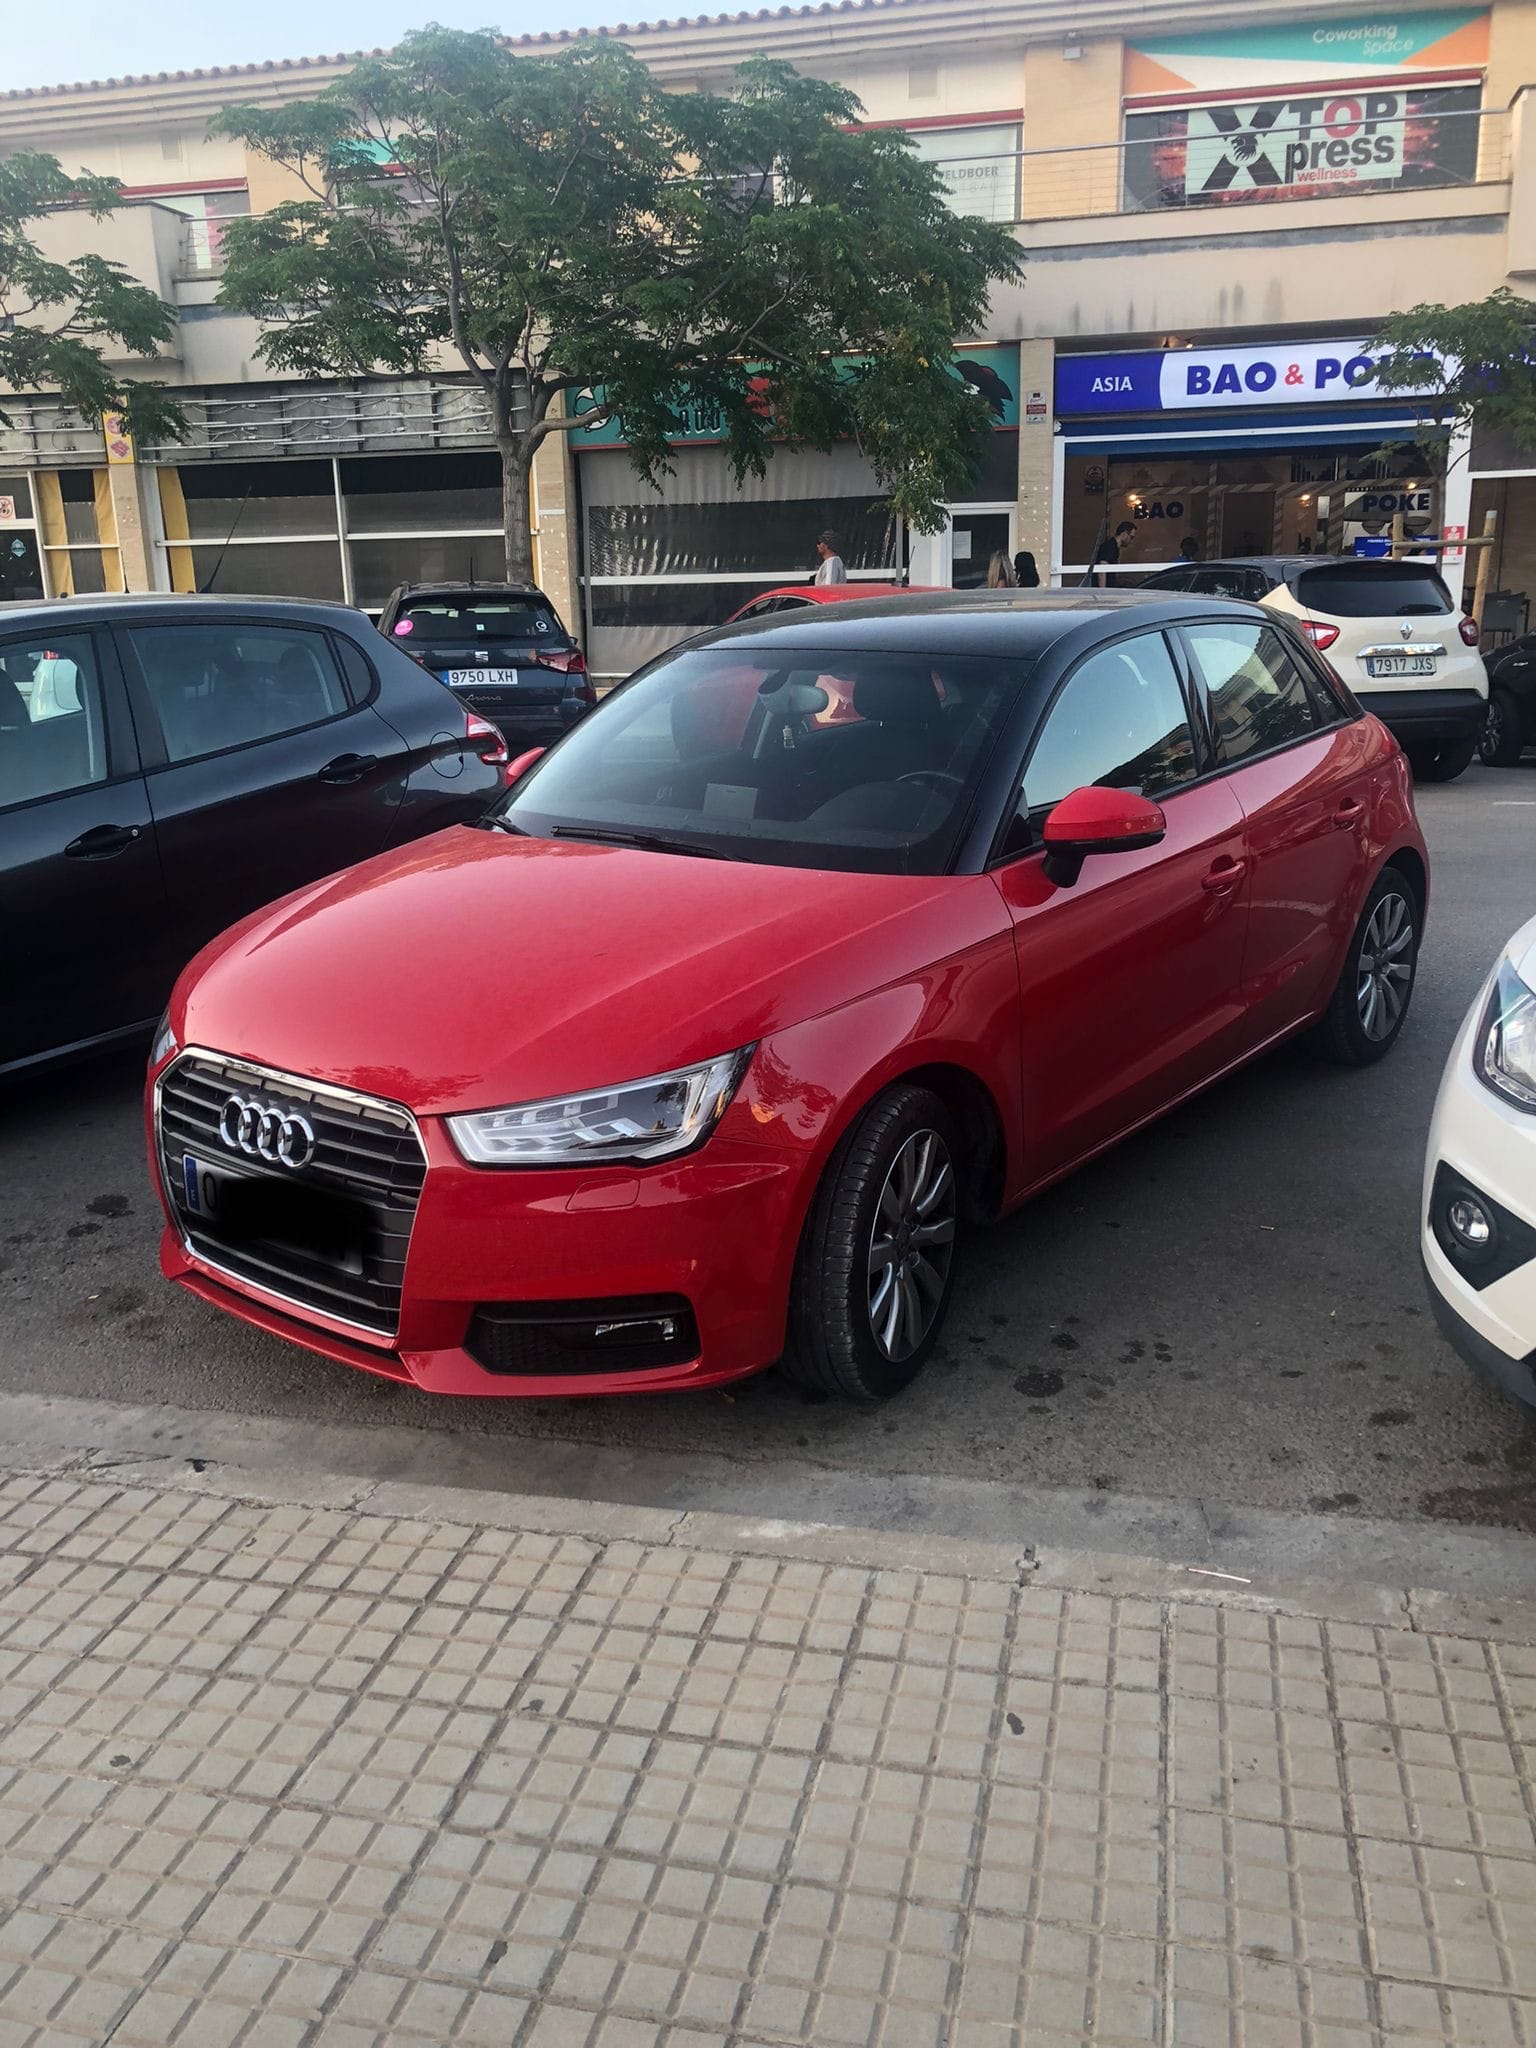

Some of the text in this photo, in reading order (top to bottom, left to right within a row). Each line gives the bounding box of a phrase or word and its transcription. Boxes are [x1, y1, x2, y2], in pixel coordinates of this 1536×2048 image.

[1312, 24, 1397, 43] Coworking
[1363, 39, 1414, 56] Space
[1289, 95, 1398, 141] TOP
[1285, 135, 1395, 184] press
[1297, 167, 1357, 182] wellness
[1186, 352, 1434, 395] BAO & PO
[1091, 376, 1133, 392] ASIA
[1133, 501, 1184, 520] BAO
[1363, 493, 1430, 513] POKE
[1376, 657, 1433, 672] 7917 JXS
[451, 671, 513, 683] 9750 LXH
